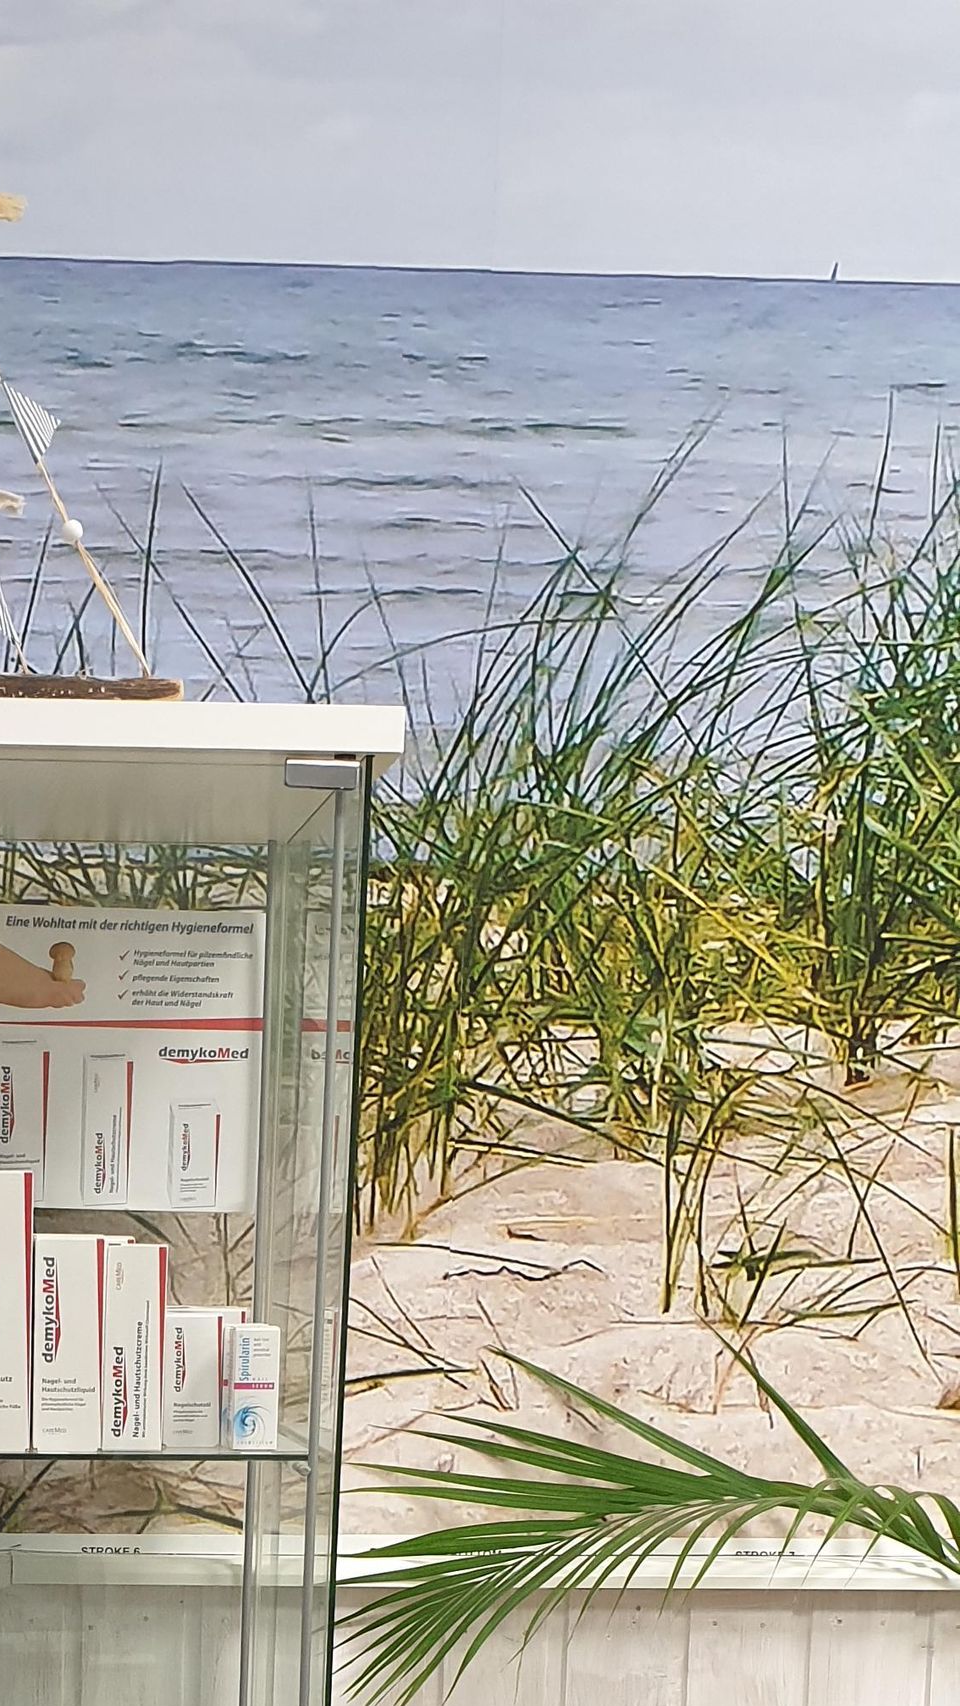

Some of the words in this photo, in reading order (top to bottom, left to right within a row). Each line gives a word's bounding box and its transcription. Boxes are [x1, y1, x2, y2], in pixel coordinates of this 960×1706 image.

[6, 915, 30, 928] Eine
[32, 917, 77, 930] Wohltat
[79, 918, 98, 930] mit
[100, 919, 118, 931] der
[120, 920, 169, 935] richtigen
[171, 921, 254, 936] Hygieneformel
[158, 1046, 250, 1062] demykoMed
[0, 1065, 14, 1144] demykoMed
[93, 1132, 106, 1195] demykoMed
[41, 1256, 60, 1364] demykoMed
[134, 1320, 144, 1393] Hautschutzcreme
[174, 1327, 185, 1393] demykoMed
[239, 1337, 252, 1381] Spirularin
[110, 1346, 128, 1438] demykoMed
[132, 1411, 141, 1438] Nagel-
